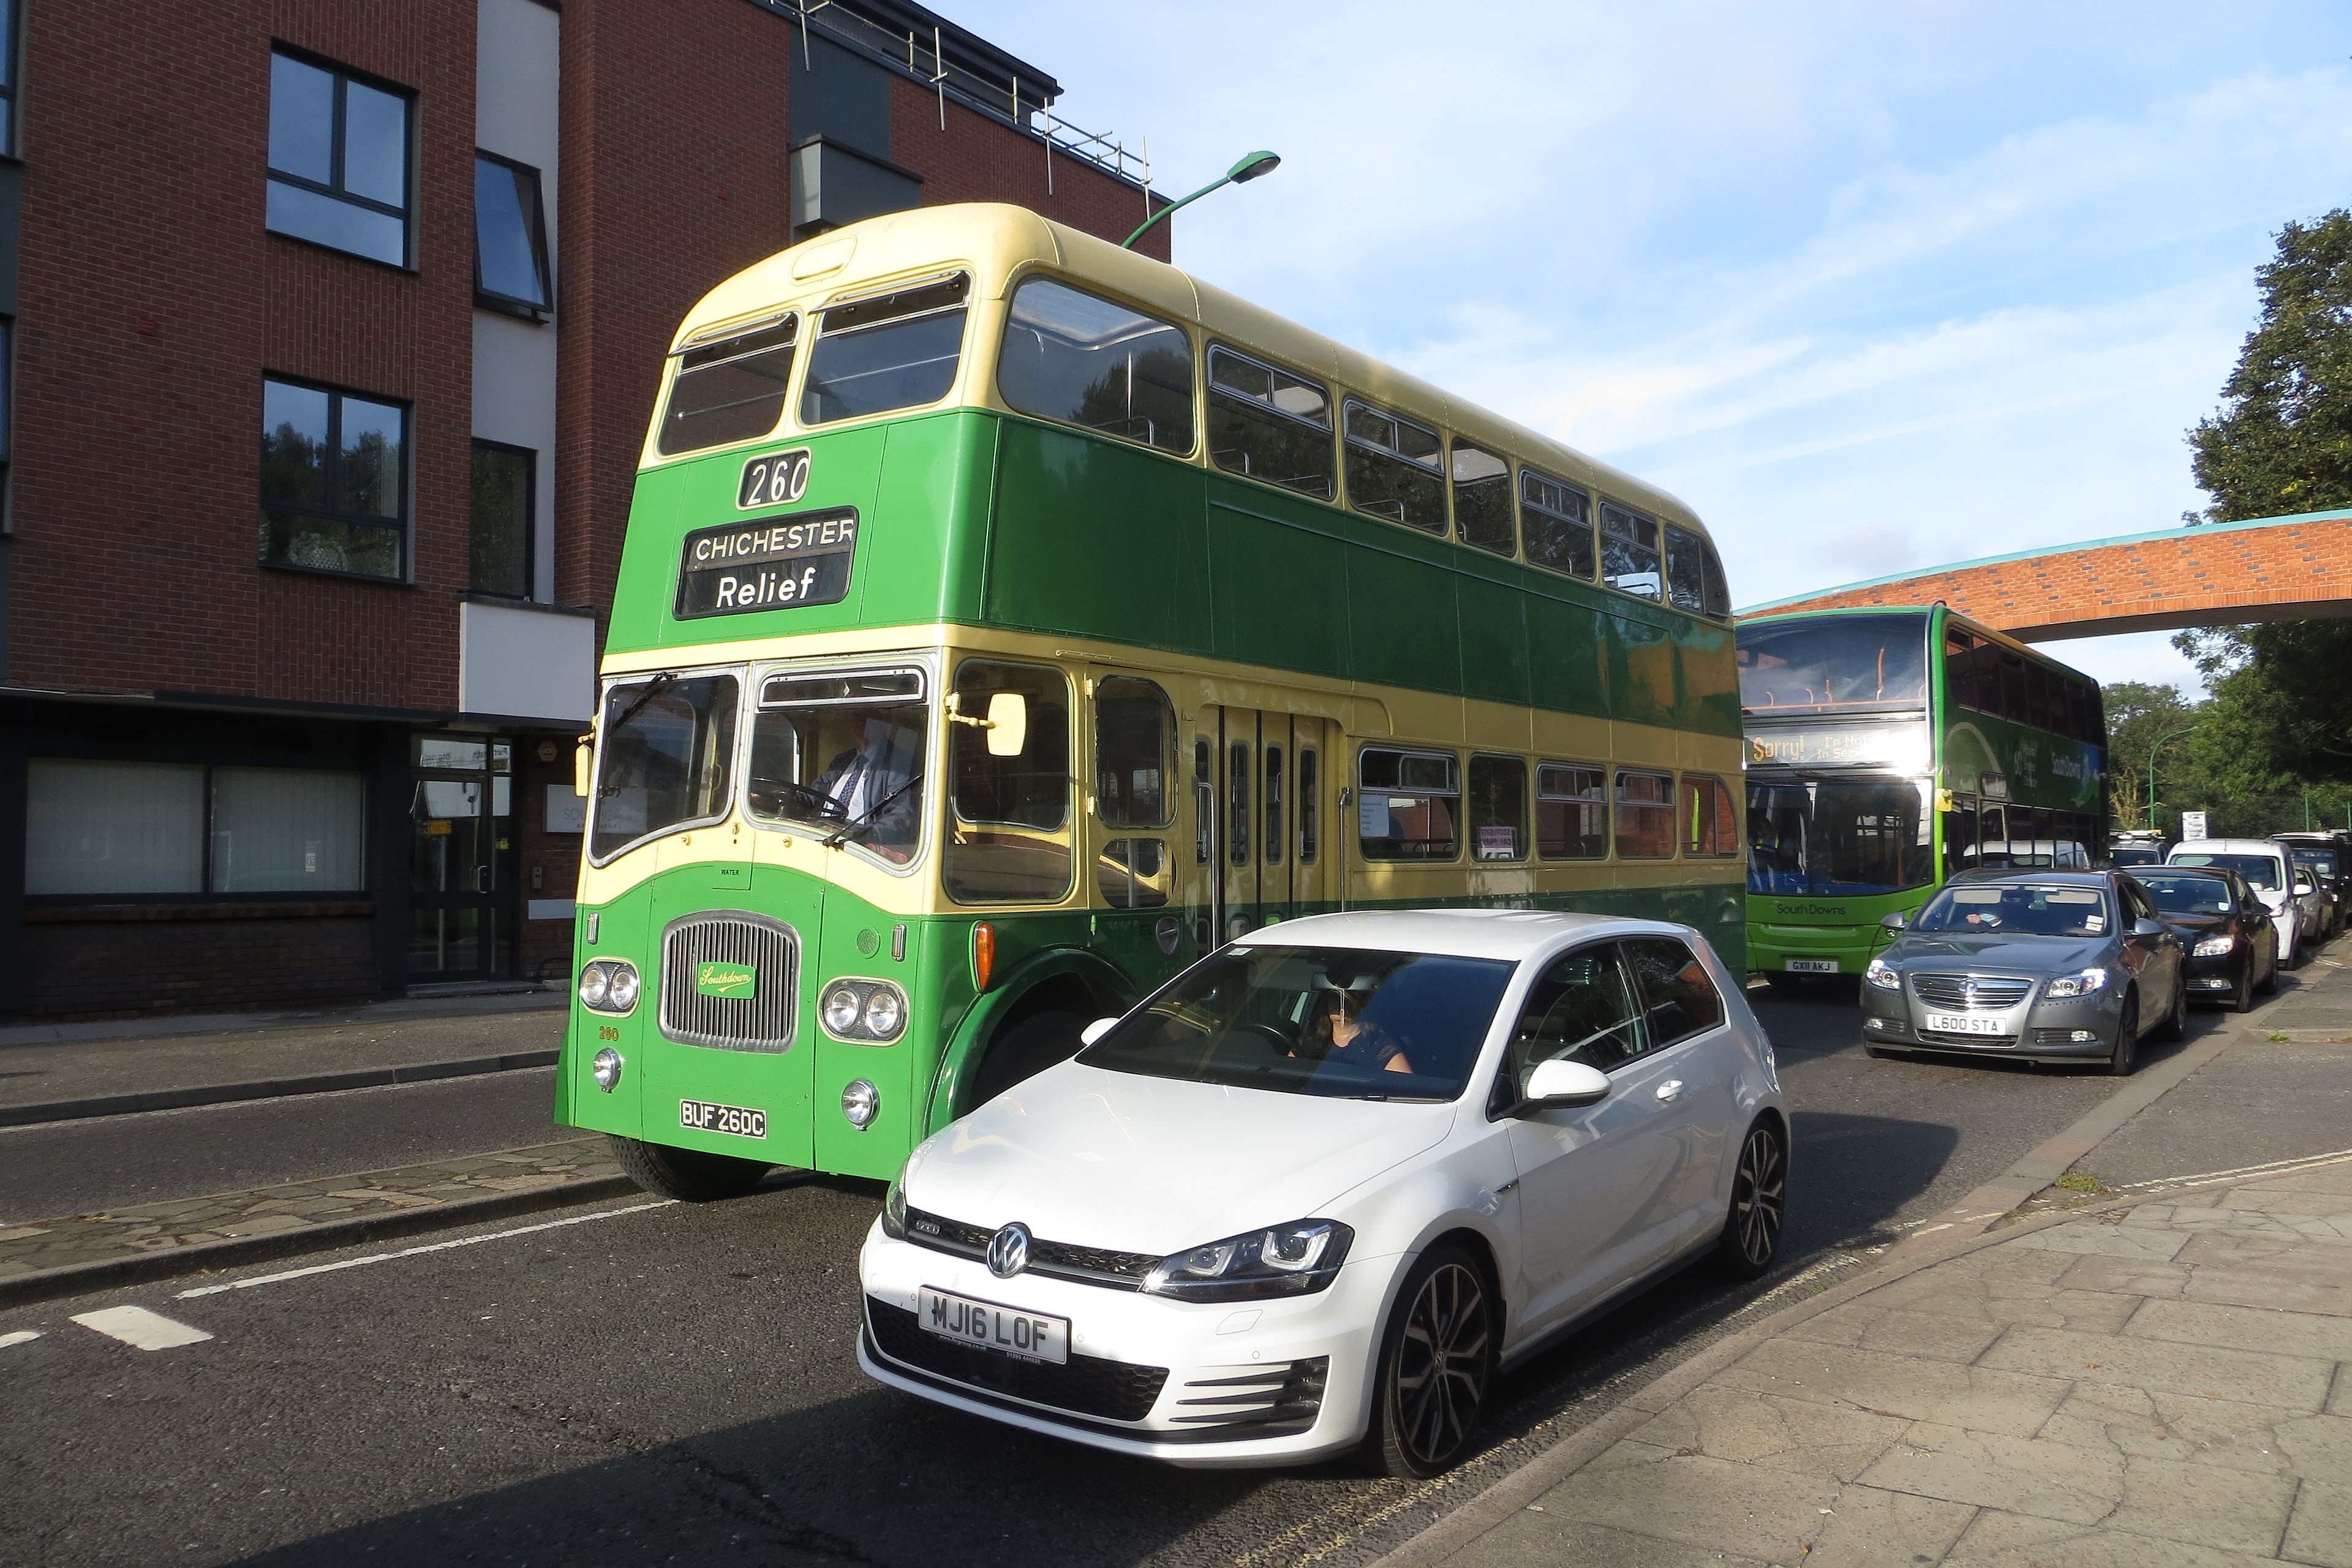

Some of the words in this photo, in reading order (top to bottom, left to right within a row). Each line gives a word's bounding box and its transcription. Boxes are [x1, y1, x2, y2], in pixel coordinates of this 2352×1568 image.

[746, 457, 809, 506] 260
[696, 519, 854, 561] CHICHESTER
[715, 567, 817, 608] Relief
[1752, 735, 1804, 762] Sorry!
[699, 965, 752, 990] Southdown
[1812, 962, 1830, 971] AKJ
[599, 1026, 619, 1042] 260
[1932, 1016, 1967, 1030] L600
[1972, 1019, 1999, 1032] STA
[682, 1102, 715, 1127] BUF
[717, 1108, 764, 1136] 260C
[932, 1295, 987, 1339] MJ16
[995, 1311, 1049, 1352] LOF
